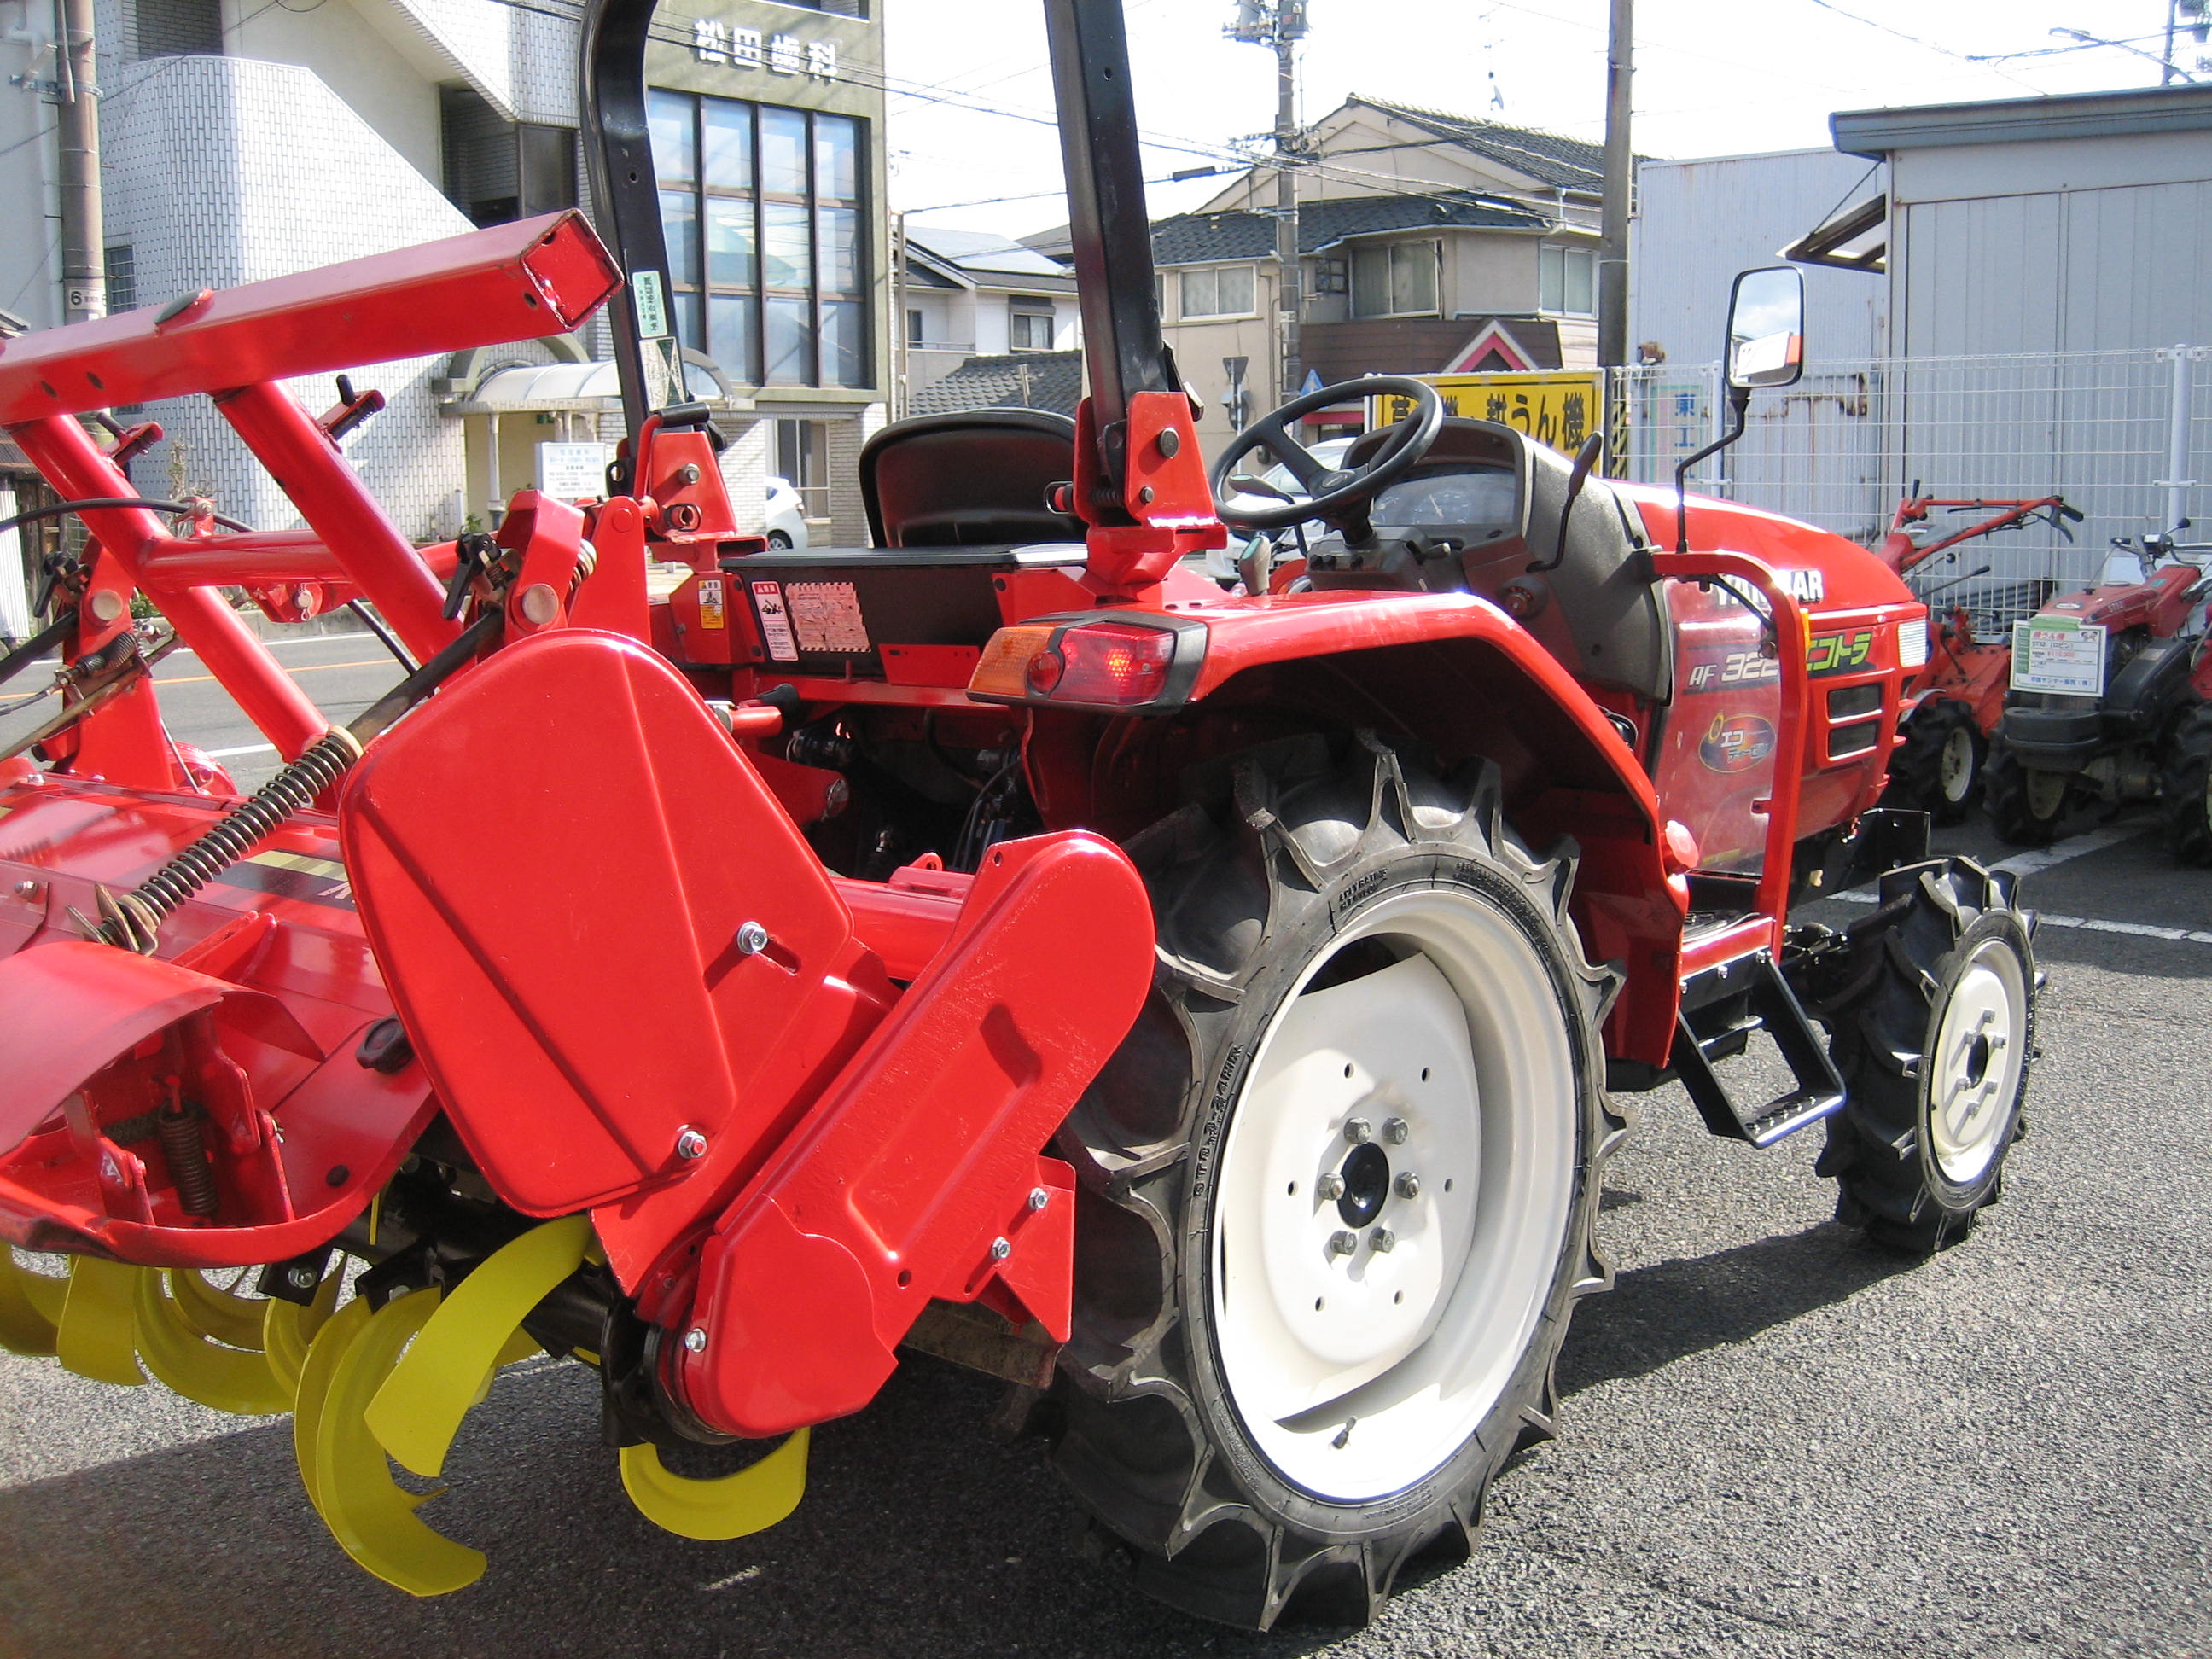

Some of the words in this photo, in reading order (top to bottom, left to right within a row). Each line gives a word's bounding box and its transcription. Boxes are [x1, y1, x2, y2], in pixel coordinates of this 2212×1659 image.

[695, 19, 838, 83] 松田歯科
[70, 290, 83, 306] 6
[1714, 568, 1824, 607] YANAR
[1806, 632, 1872, 672] コトラ
[1688, 663, 1718, 688] AF
[1720, 730, 1744, 748] エコ
